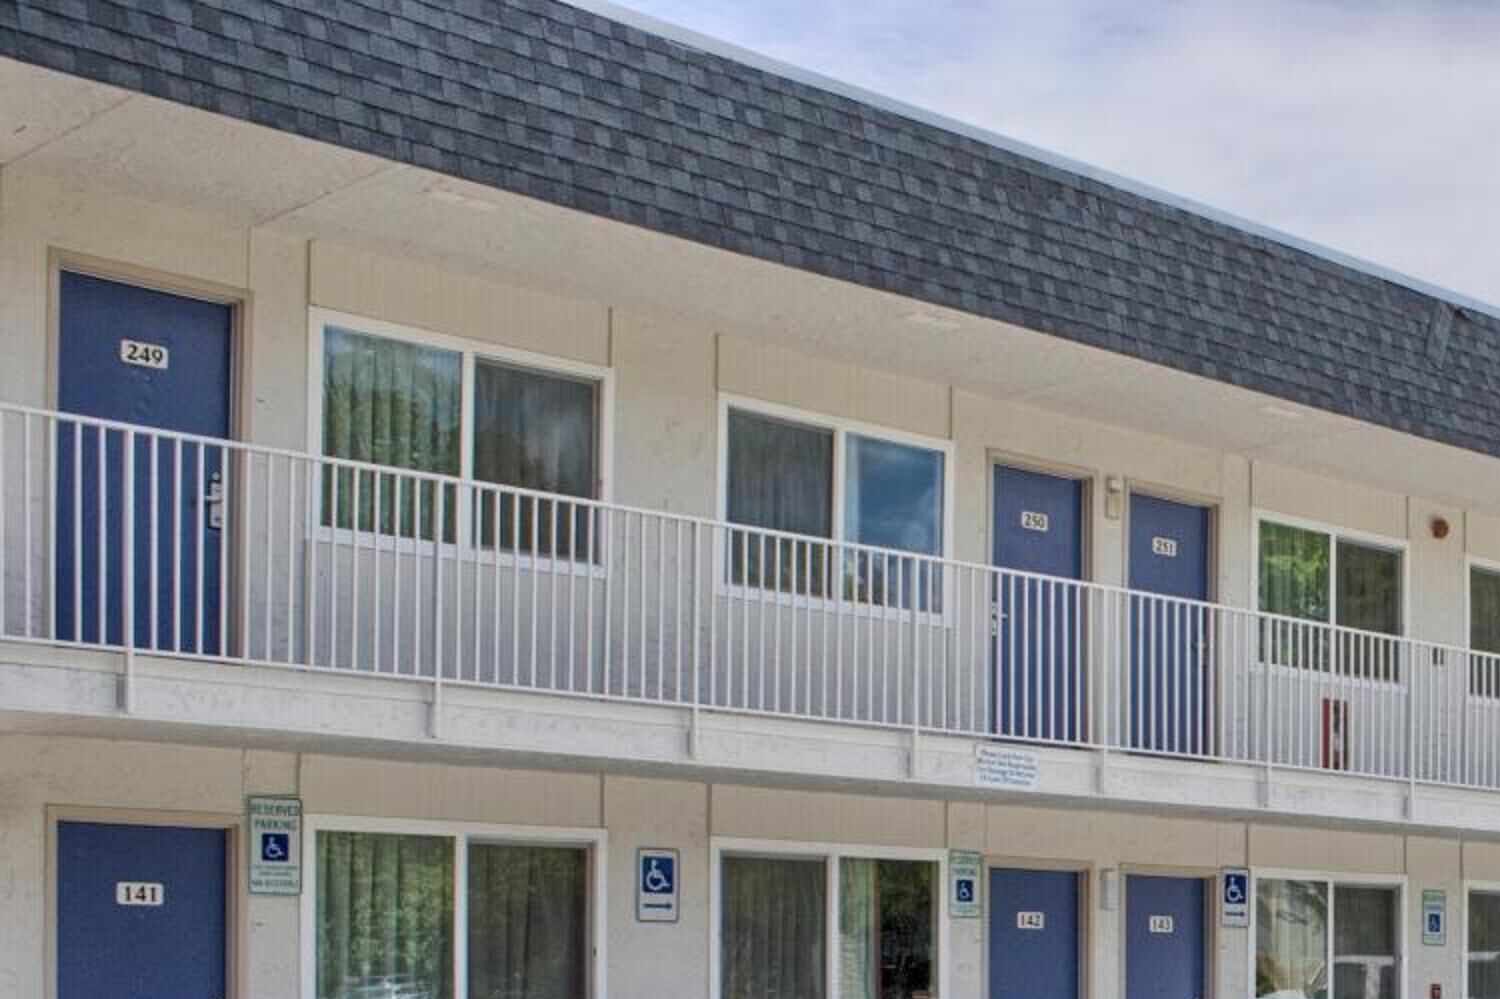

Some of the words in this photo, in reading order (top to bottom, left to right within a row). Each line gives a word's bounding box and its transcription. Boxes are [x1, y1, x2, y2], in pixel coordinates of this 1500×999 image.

[127, 343, 163, 365] 249
[1024, 513, 1045, 529] 250
[1155, 539, 1174, 554] 251
[125, 885, 157, 902] 141
[1021, 914, 1041, 927] 142
